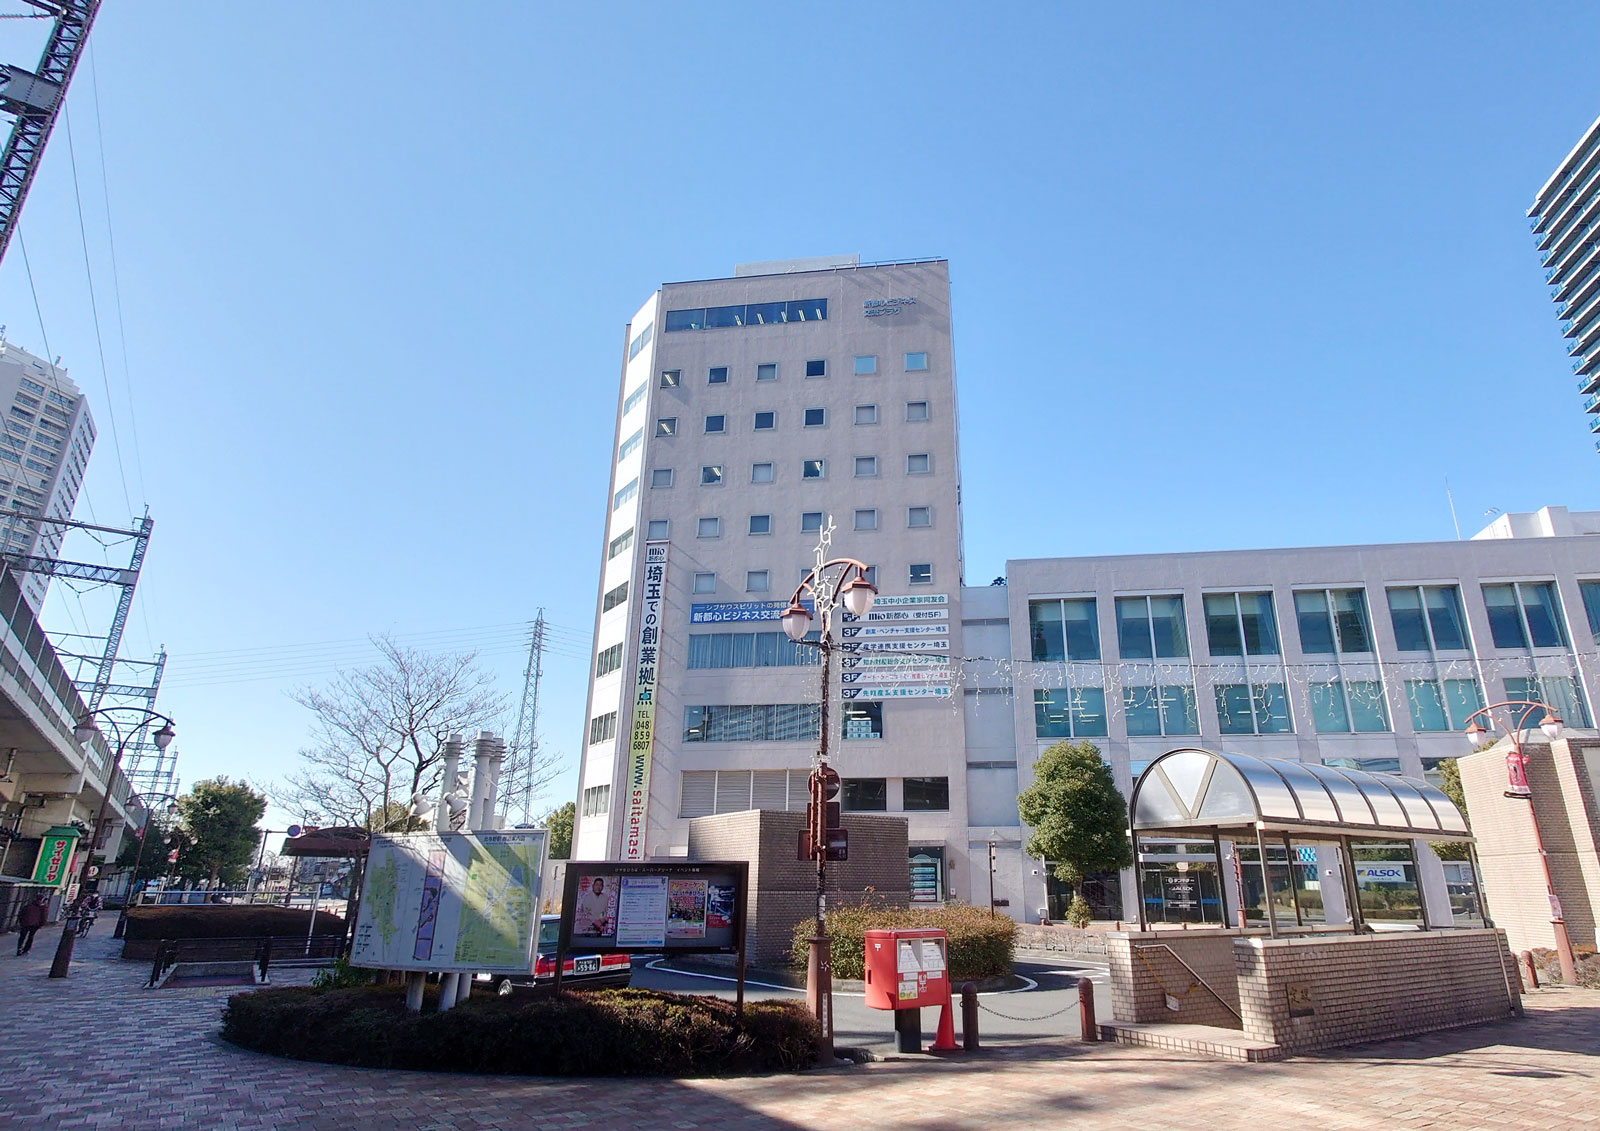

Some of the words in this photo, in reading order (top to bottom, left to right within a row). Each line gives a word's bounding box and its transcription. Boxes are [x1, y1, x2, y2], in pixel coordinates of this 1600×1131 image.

[649, 548, 665, 556] mio
[693, 610, 783, 622] 新都心ビジネス交流
[637, 566, 663, 705] 埼玉での創業拠点
[844, 629, 858, 637] 3F
[843, 674, 857, 682] 3F
[843, 690, 857, 698] 3F
[638, 710, 650, 718] TEL
[634, 731, 650, 740] 859
[633, 741, 650, 750] 6807
[46, 840, 67, 882] サイゼリヤ
[1367, 869, 1401, 877] ALSOK
